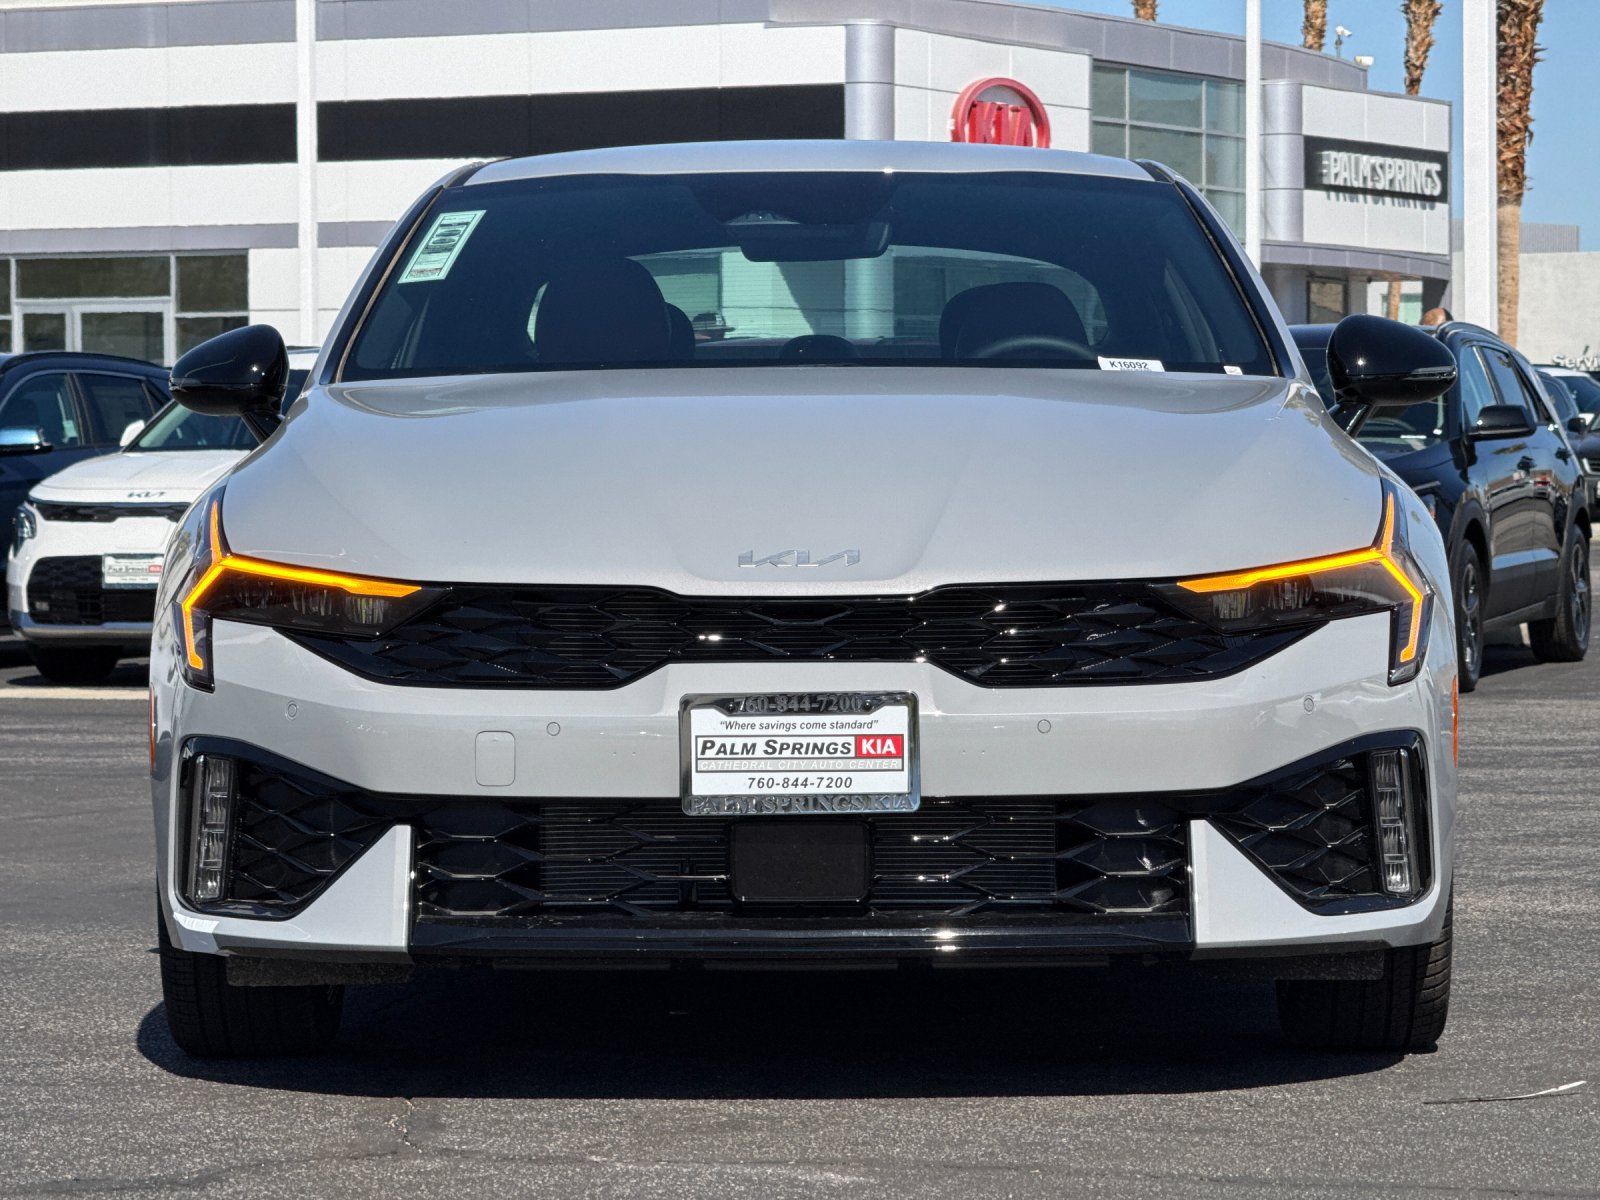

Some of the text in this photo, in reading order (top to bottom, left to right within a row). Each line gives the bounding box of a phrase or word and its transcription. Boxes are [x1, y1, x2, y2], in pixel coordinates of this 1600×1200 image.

[1324, 151, 1442, 196] PALM SPRINGS
[1108, 360, 1149, 370] K16092
[738, 549, 860, 568] KIA
[736, 694, 863, 713] 760-844-7200
[759, 721, 797, 732] savings
[800, 722, 827, 730] come
[700, 738, 897, 756] PALM SPRINGS KIA
[701, 759, 899, 770] CATHEDRAL CITY AUTO CENTER
[747, 776, 853, 789] 760-844-7200
[691, 793, 914, 814] PALM SPRINGS KIA
